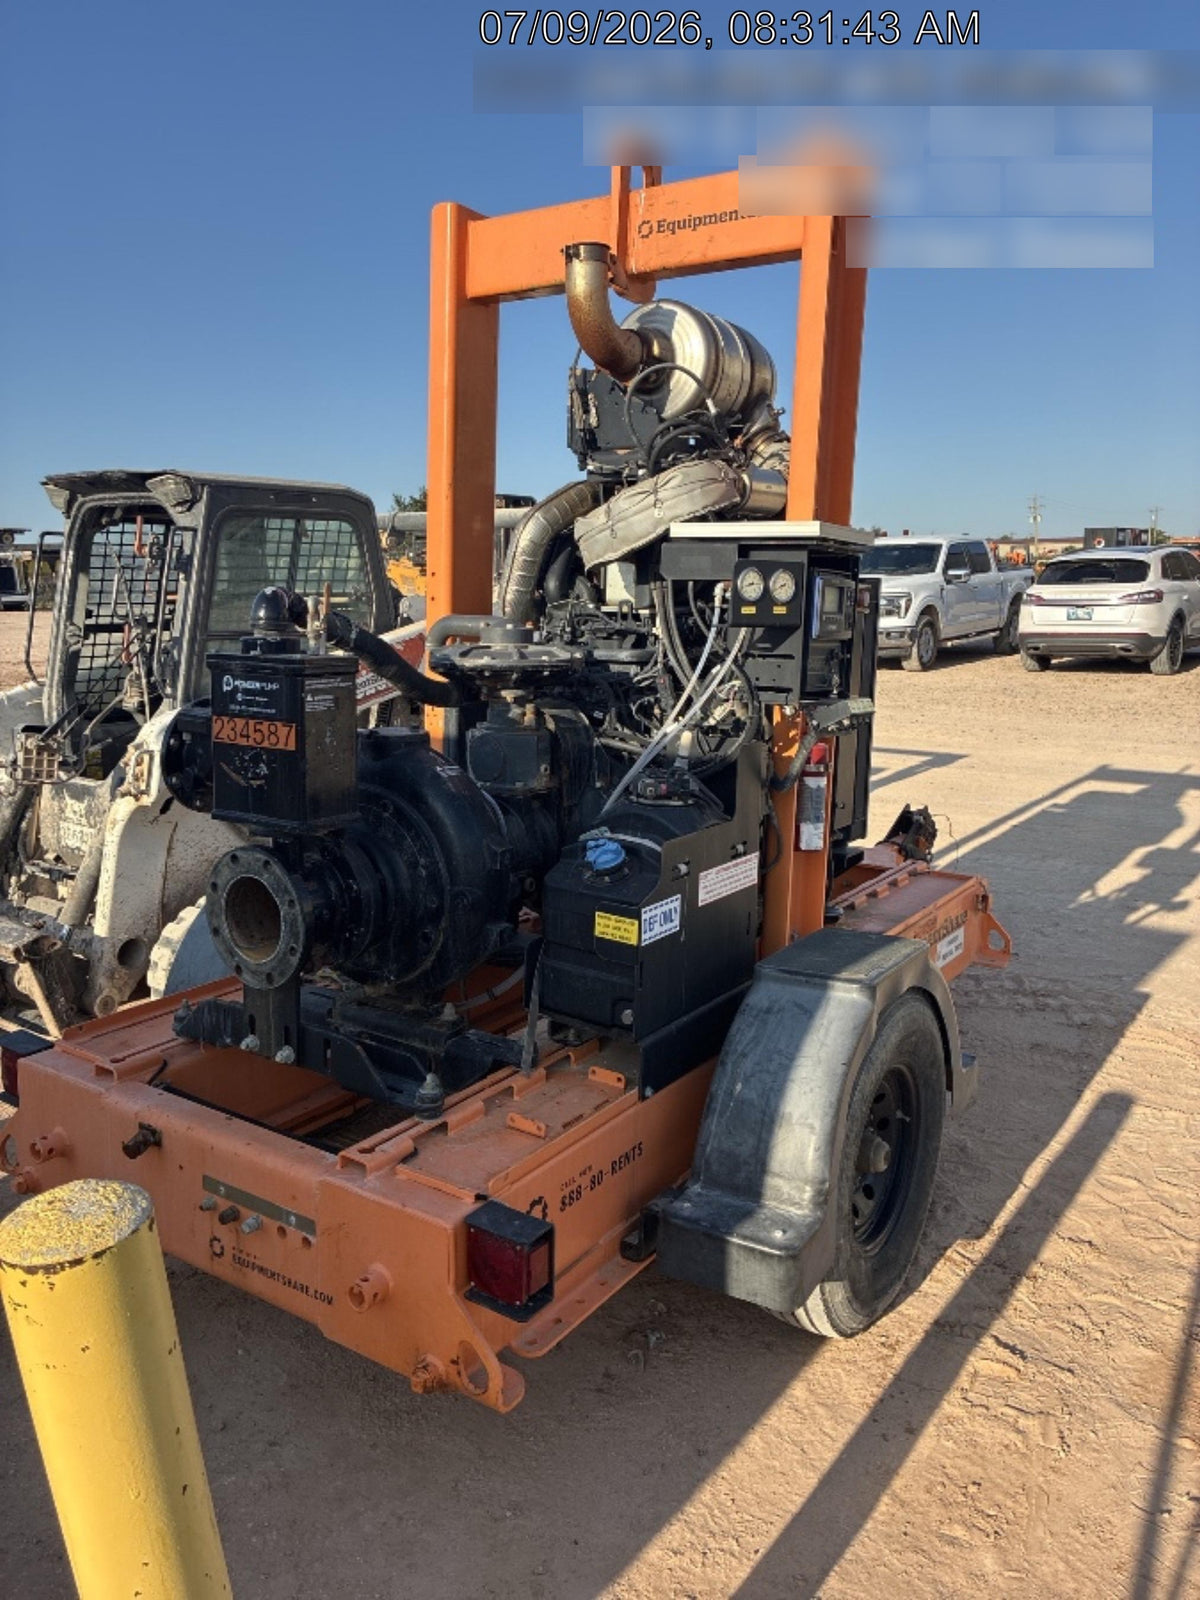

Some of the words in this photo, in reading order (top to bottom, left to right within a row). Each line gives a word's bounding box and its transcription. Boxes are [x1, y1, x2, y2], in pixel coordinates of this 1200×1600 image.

[656, 208, 745, 235] Equipmen
[213, 717, 294, 748] 234587
[559, 1140, 643, 1213] 888-80-RENTS
